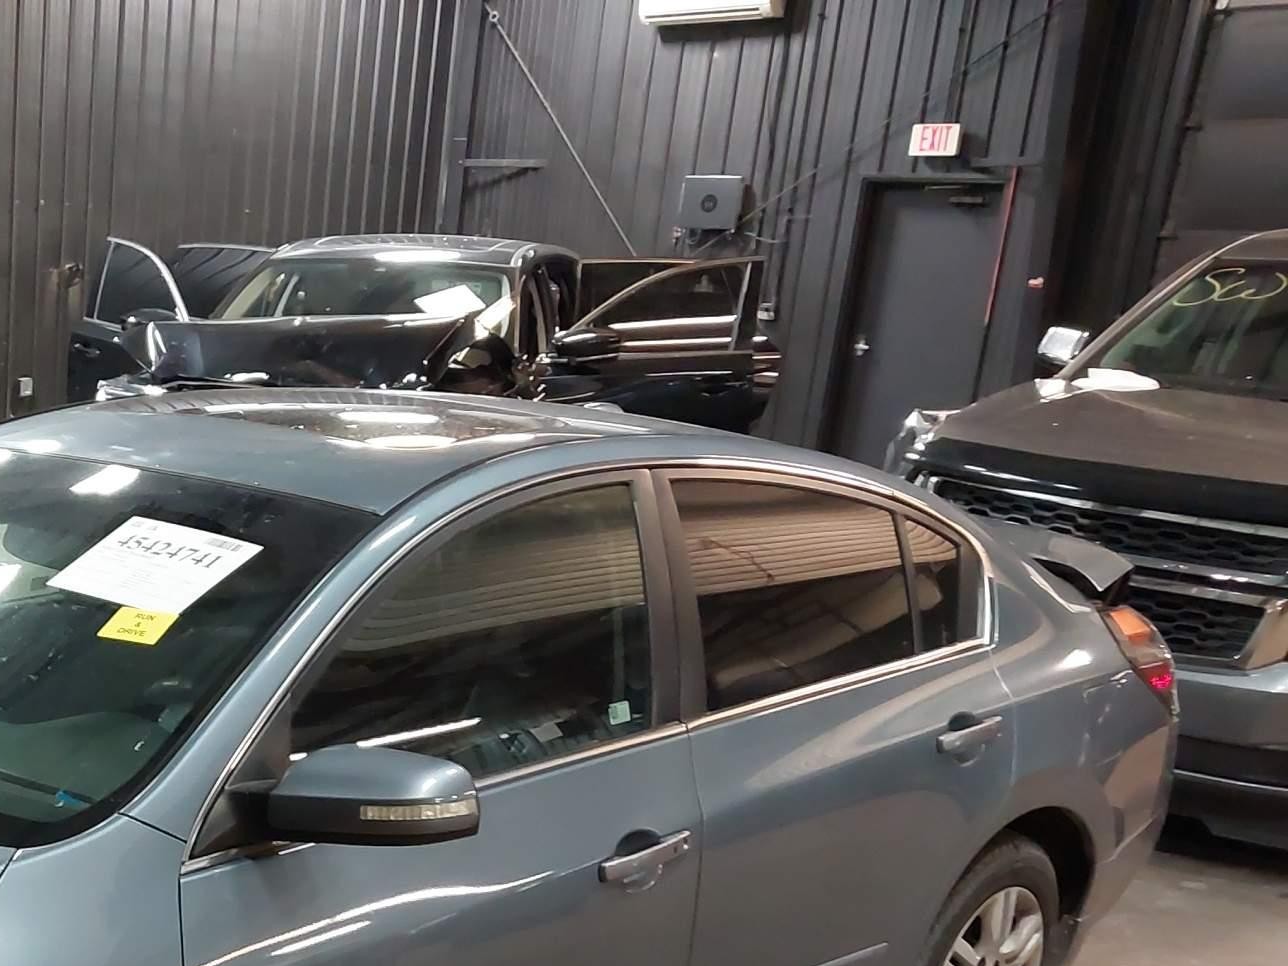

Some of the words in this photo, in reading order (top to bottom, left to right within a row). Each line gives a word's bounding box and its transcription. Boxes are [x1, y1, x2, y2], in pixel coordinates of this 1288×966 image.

[919, 125, 953, 152] EXIT
[117, 534, 222, 568] 45424741
[135, 612, 157, 621] RUN
[116, 627, 147, 637] DRIVE
